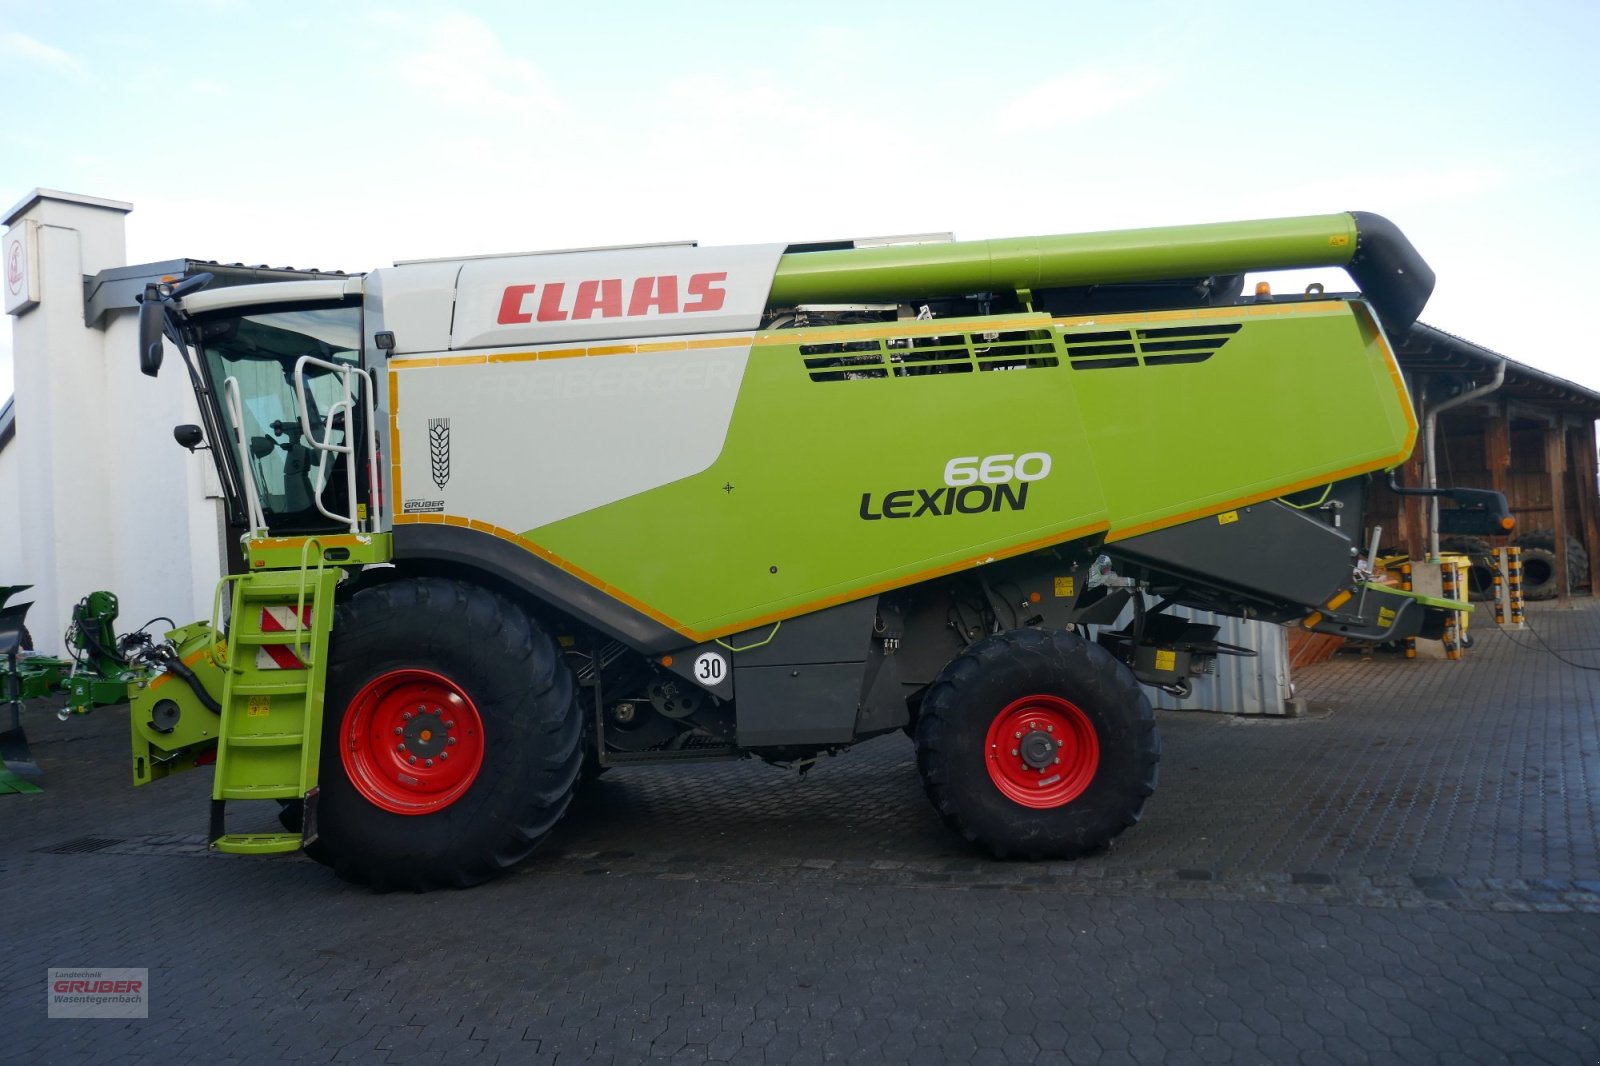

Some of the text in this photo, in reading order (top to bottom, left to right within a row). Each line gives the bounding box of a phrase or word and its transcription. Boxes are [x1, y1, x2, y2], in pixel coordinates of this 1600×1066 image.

[498, 272, 727, 325] CLAAS
[943, 451, 1052, 487] 660
[404, 500, 445, 508] GRUBER
[860, 481, 1029, 520] LEXION
[700, 658, 721, 678] 30
